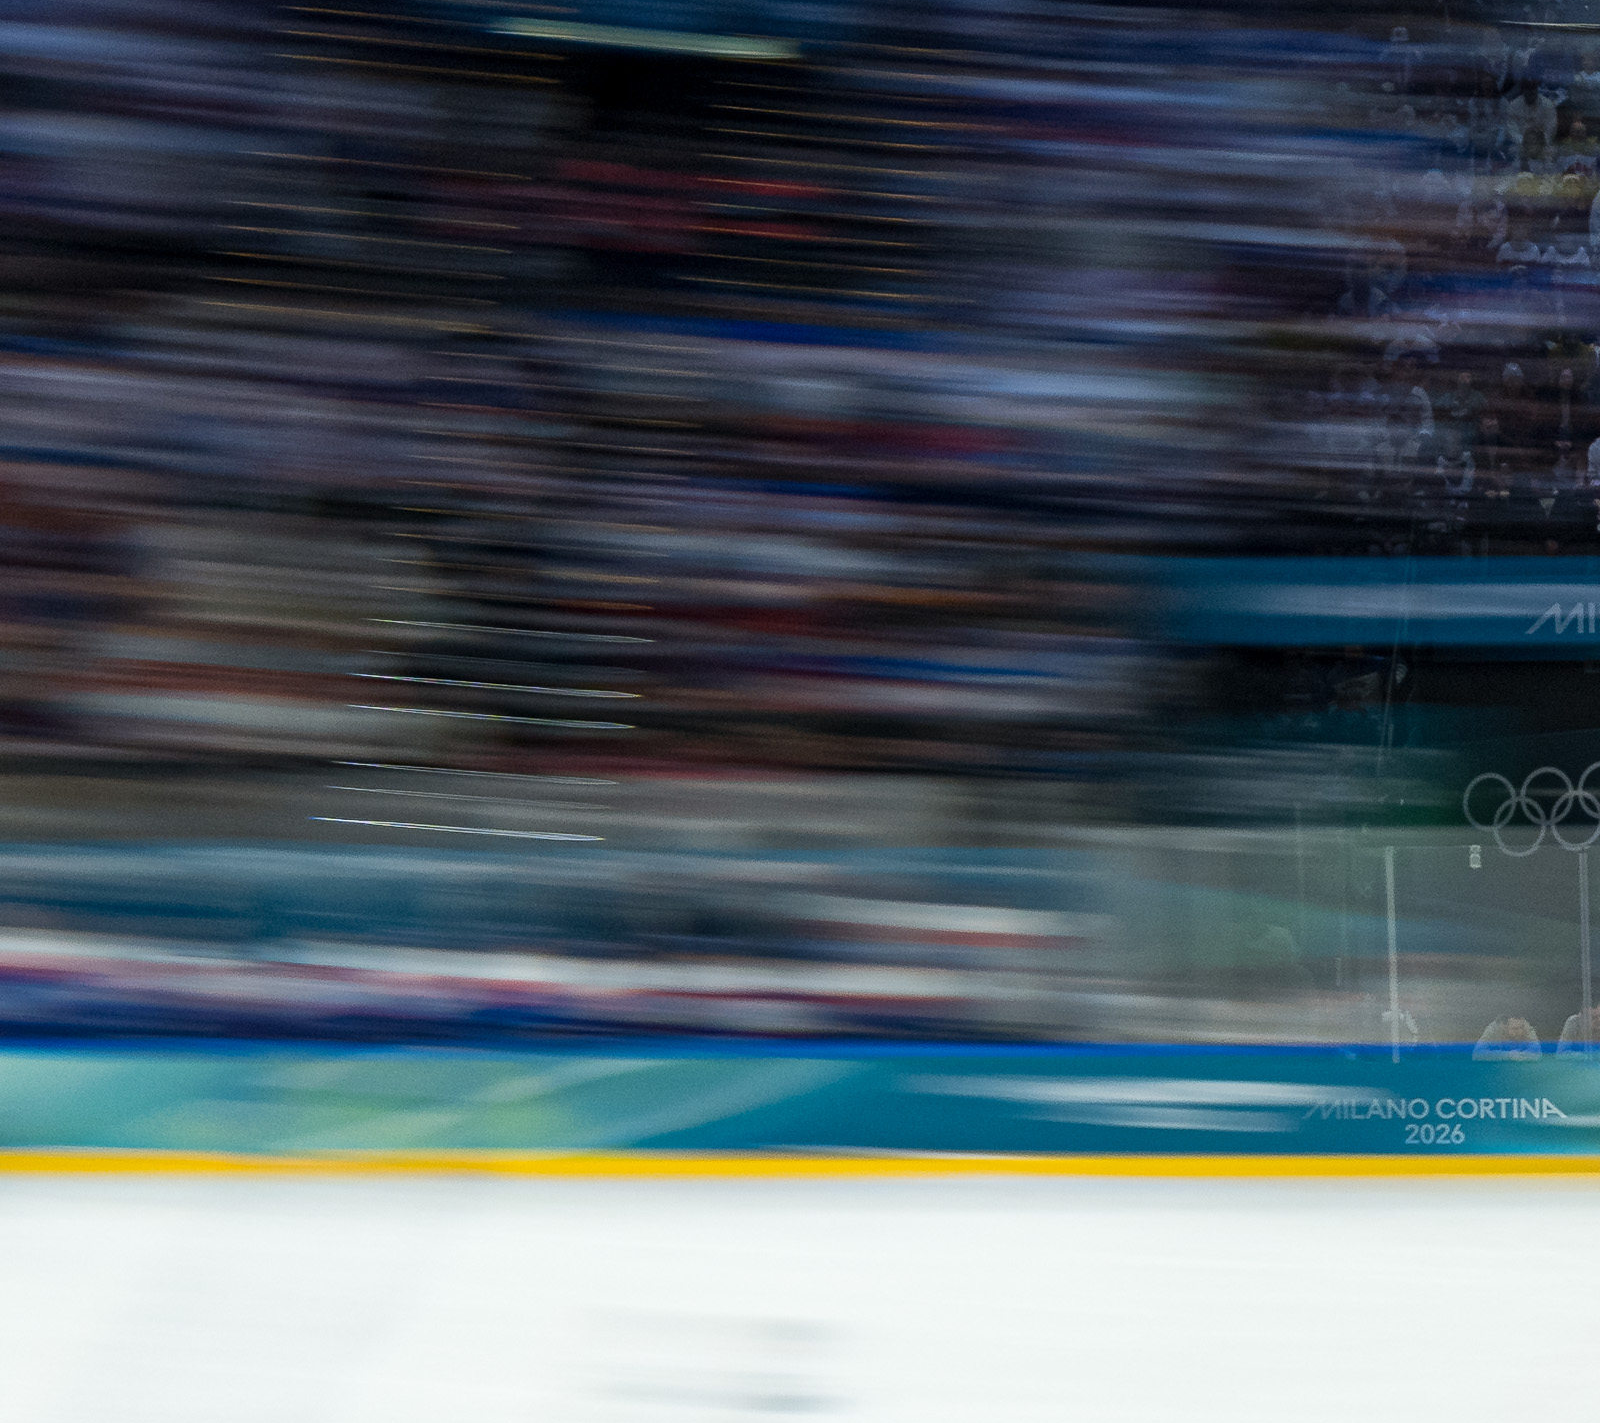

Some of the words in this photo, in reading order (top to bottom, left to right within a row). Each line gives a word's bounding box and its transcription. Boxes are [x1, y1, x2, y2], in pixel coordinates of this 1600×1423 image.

[1302, 1097, 1430, 1121] MILANO
[1435, 1097, 1568, 1119] CORTINA
[1404, 1123, 1466, 1145] 2026
